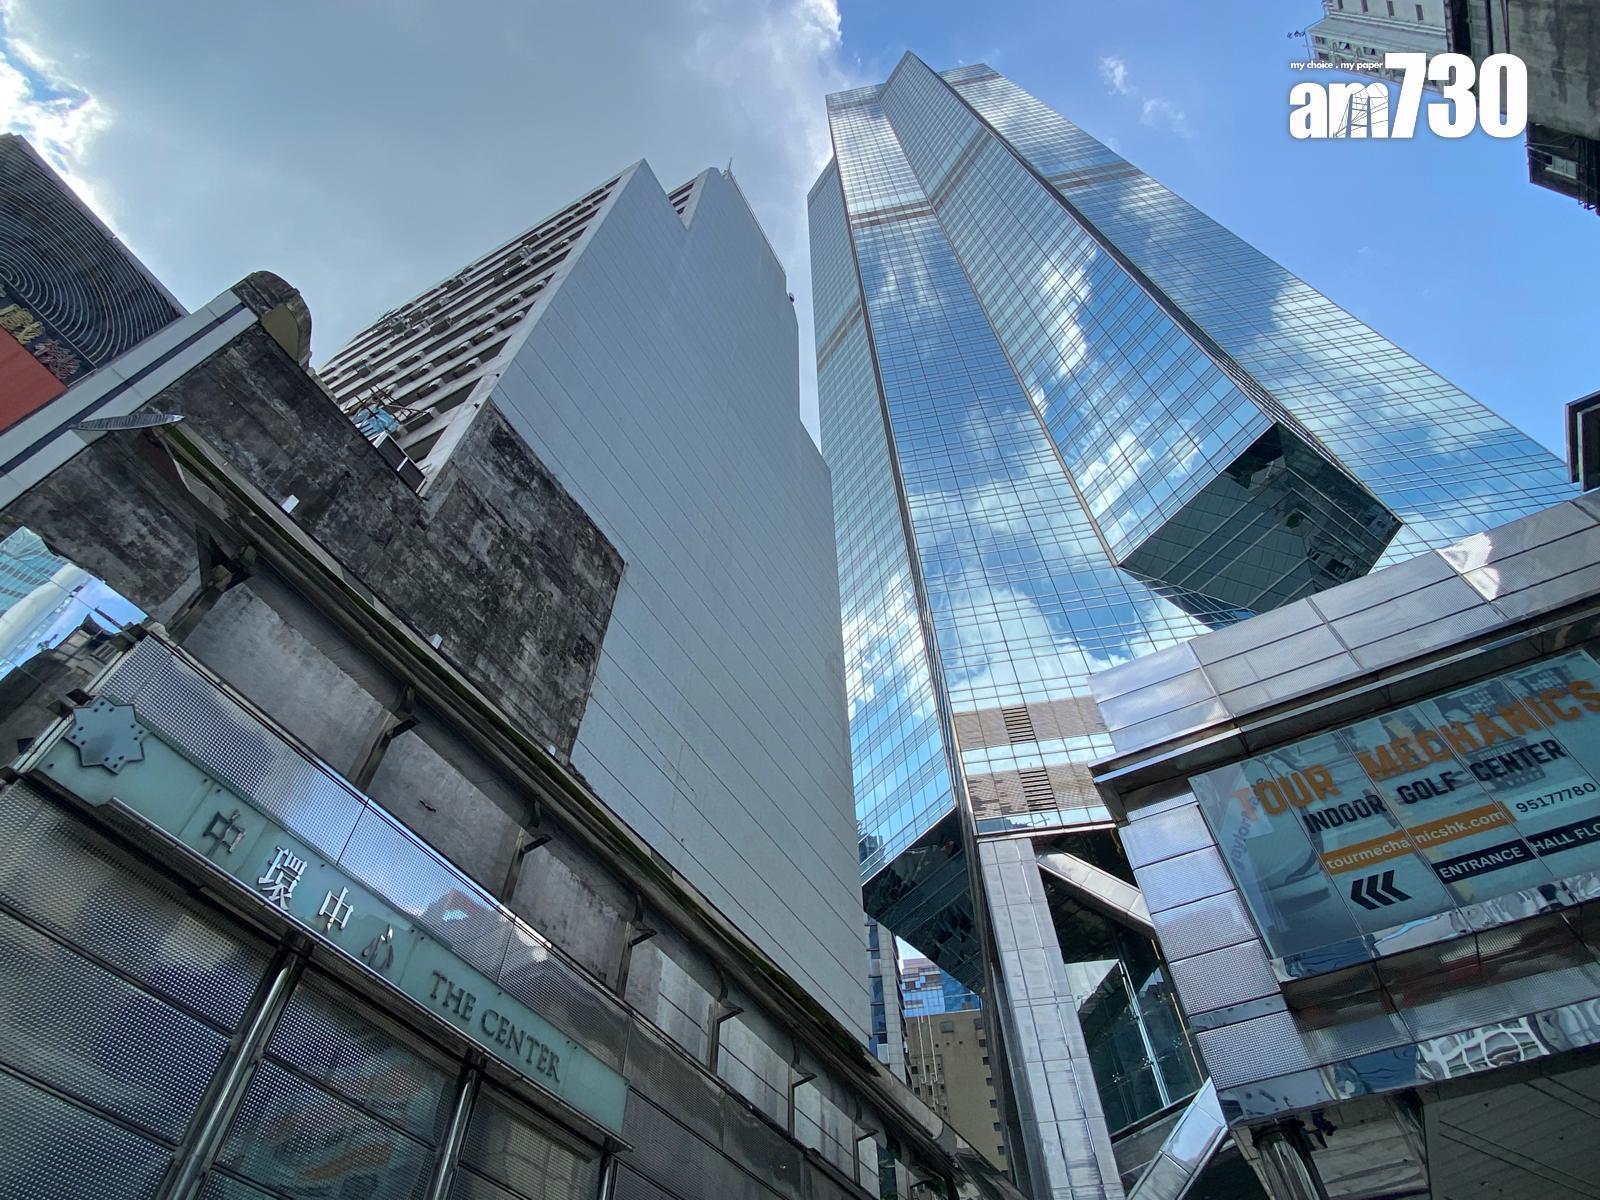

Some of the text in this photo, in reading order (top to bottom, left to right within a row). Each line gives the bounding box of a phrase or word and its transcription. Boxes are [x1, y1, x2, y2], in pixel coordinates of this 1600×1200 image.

[1232, 680, 1600, 822] TOUR MECHANICS
[1302, 740, 1567, 834] INDOOR GOLF CENTER
[1516, 782, 1597, 813] 95177780
[1326, 811, 1505, 870] tourmechanicshk.com
[1439, 846, 1525, 879] ENTRANCE
[1528, 832, 1575, 852] HALL
[203, 809, 395, 970] 中環中心
[429, 969, 561, 1082] THE CENTER
